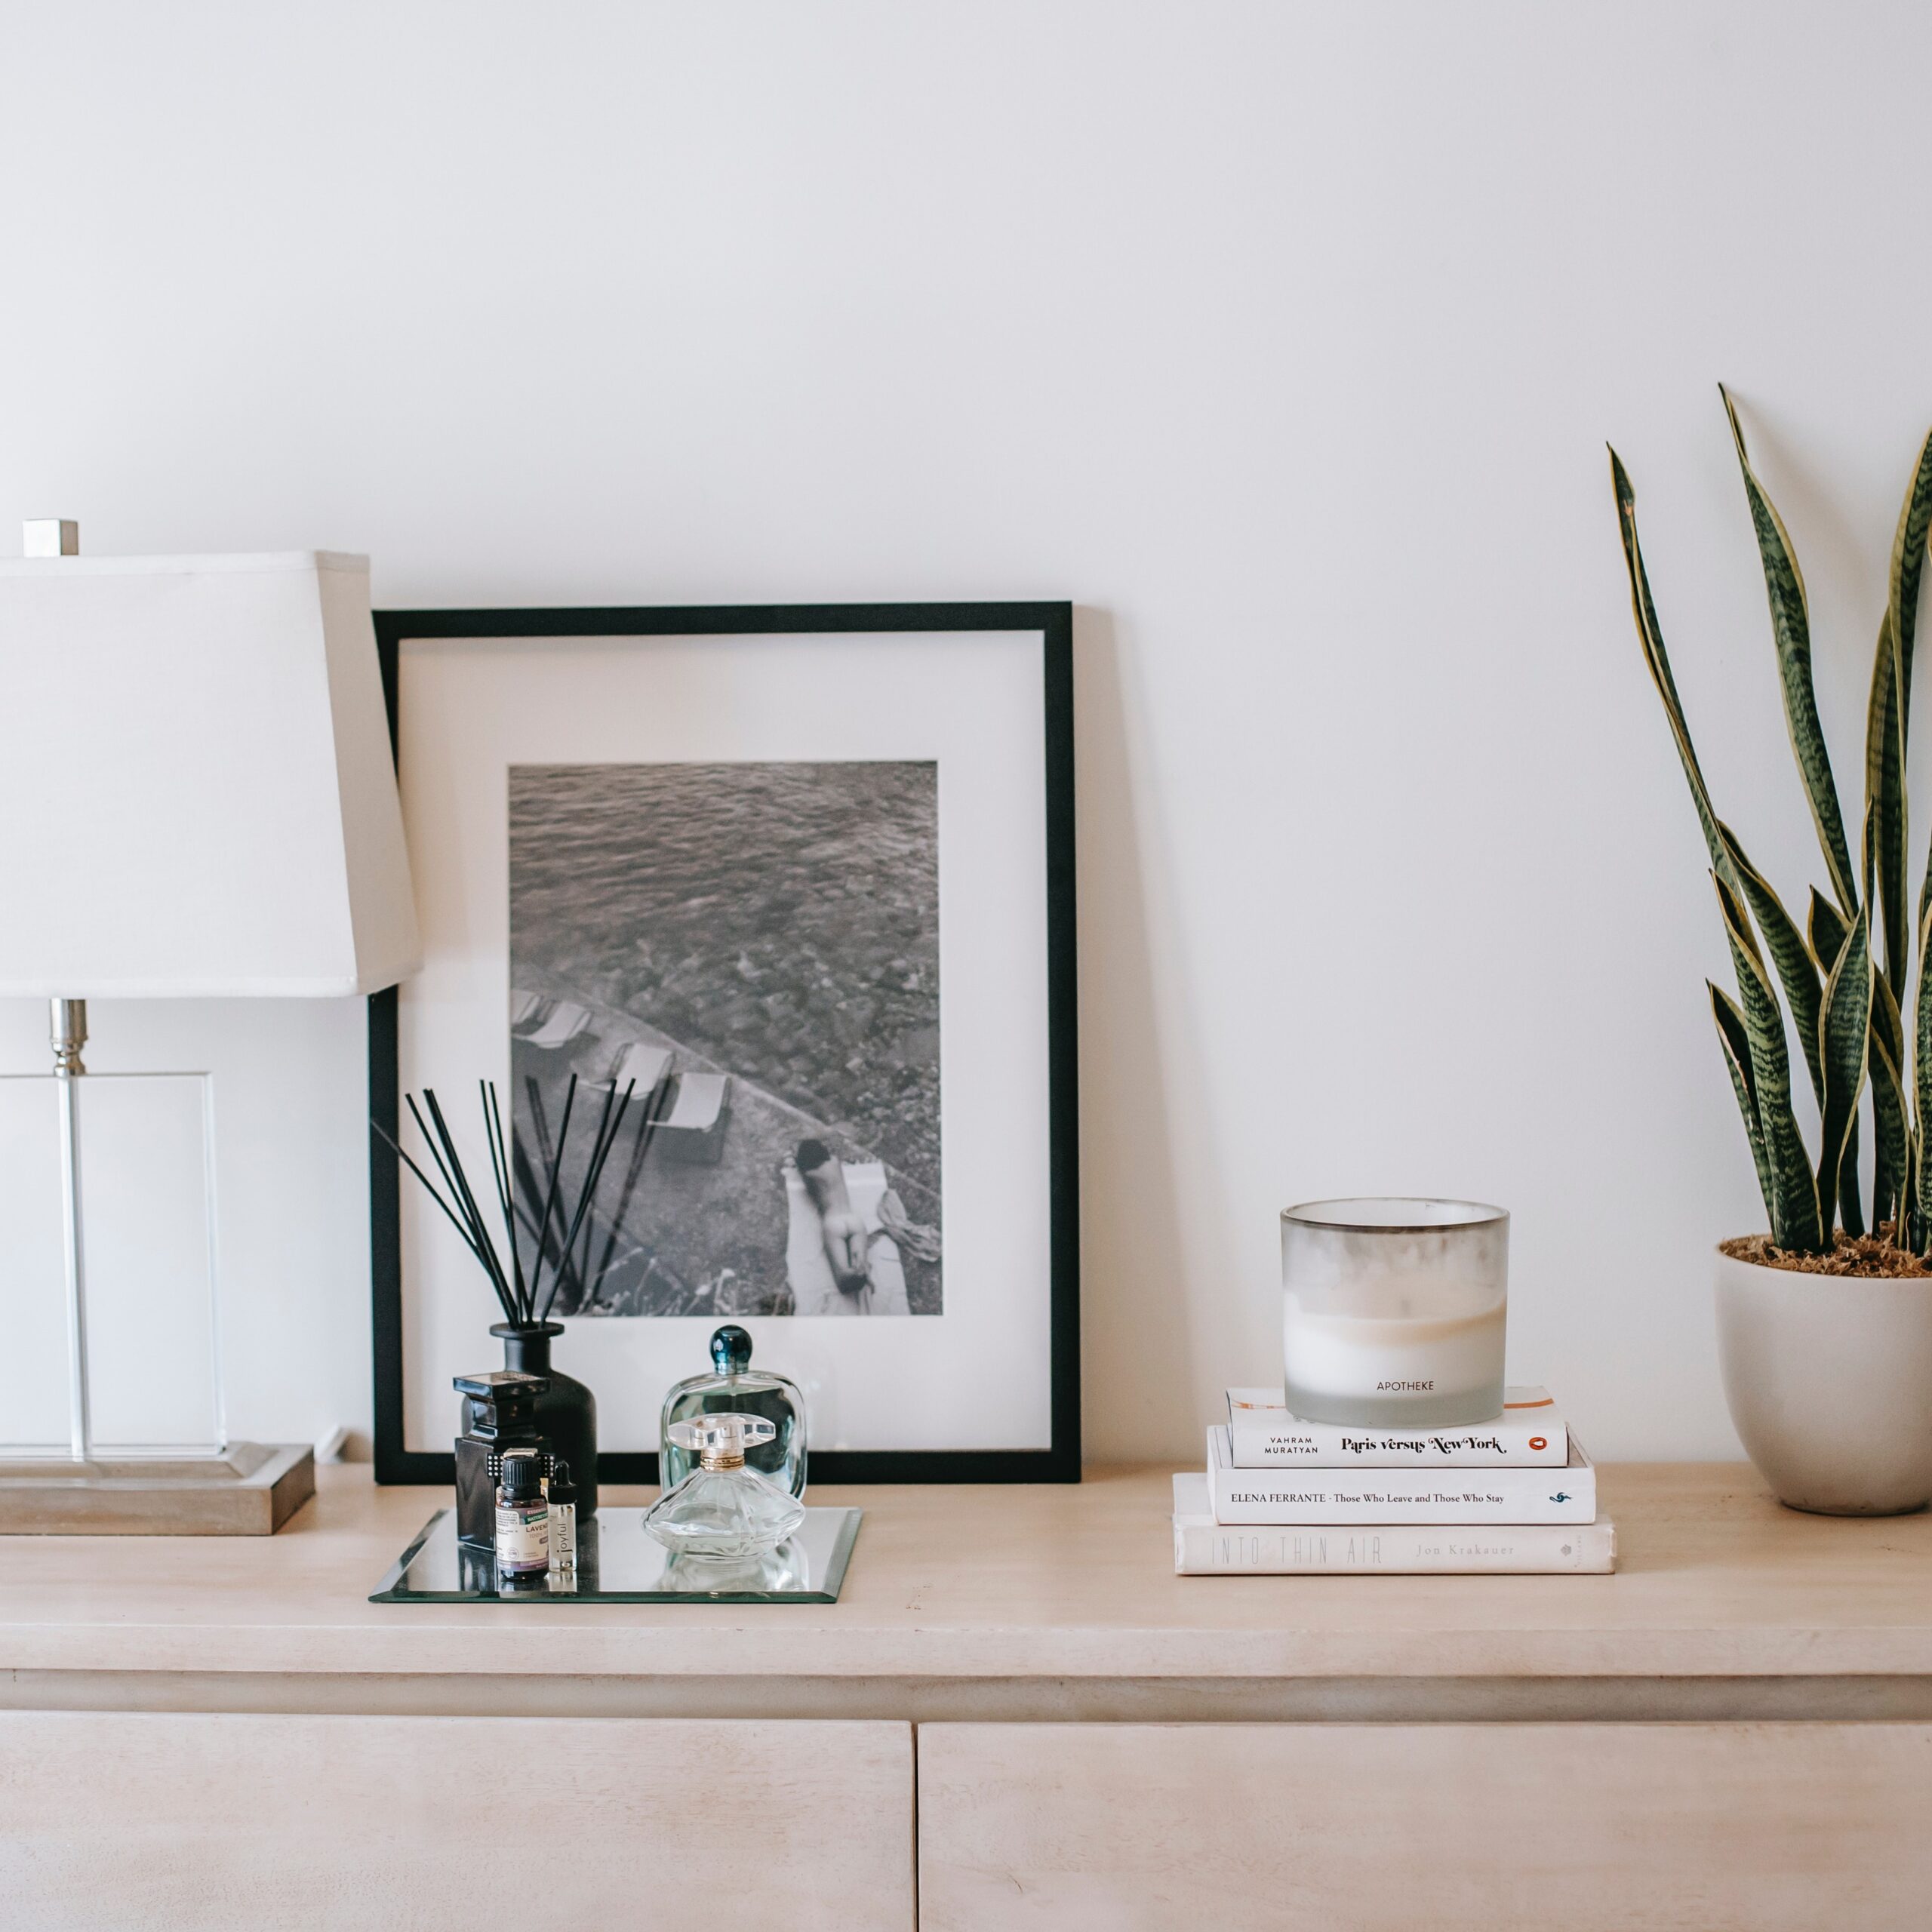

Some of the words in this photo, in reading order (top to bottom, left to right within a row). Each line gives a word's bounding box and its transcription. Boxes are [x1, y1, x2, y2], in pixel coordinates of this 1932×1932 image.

[1377, 1381, 1434, 1391] APOTHEKE
[1341, 1438, 1376, 1454] Paris
[1380, 1438, 1425, 1454] versus
[1428, 1437, 1463, 1454] New
[1463, 1437, 1507, 1454] York
[1231, 1494, 1266, 1503] ELENA
[1269, 1494, 1326, 1503] FERRANTE
[1334, 1494, 1361, 1503] Those
[1363, 1494, 1384, 1503] Who
[1387, 1494, 1412, 1503] Leave
[1415, 1494, 1430, 1503] and
[1433, 1494, 1460, 1503] Those
[1463, 1494, 1484, 1503] Who
[1486, 1494, 1504, 1504] Stay
[556, 1523, 574, 1553] joyful
[1212, 1537, 1259, 1564] INTO
[1280, 1537, 1327, 1564] THIN
[1347, 1537, 1381, 1564] AIR
[1417, 1544, 1440, 1557] Jon
[1449, 1544, 1514, 1555] Krakauer
